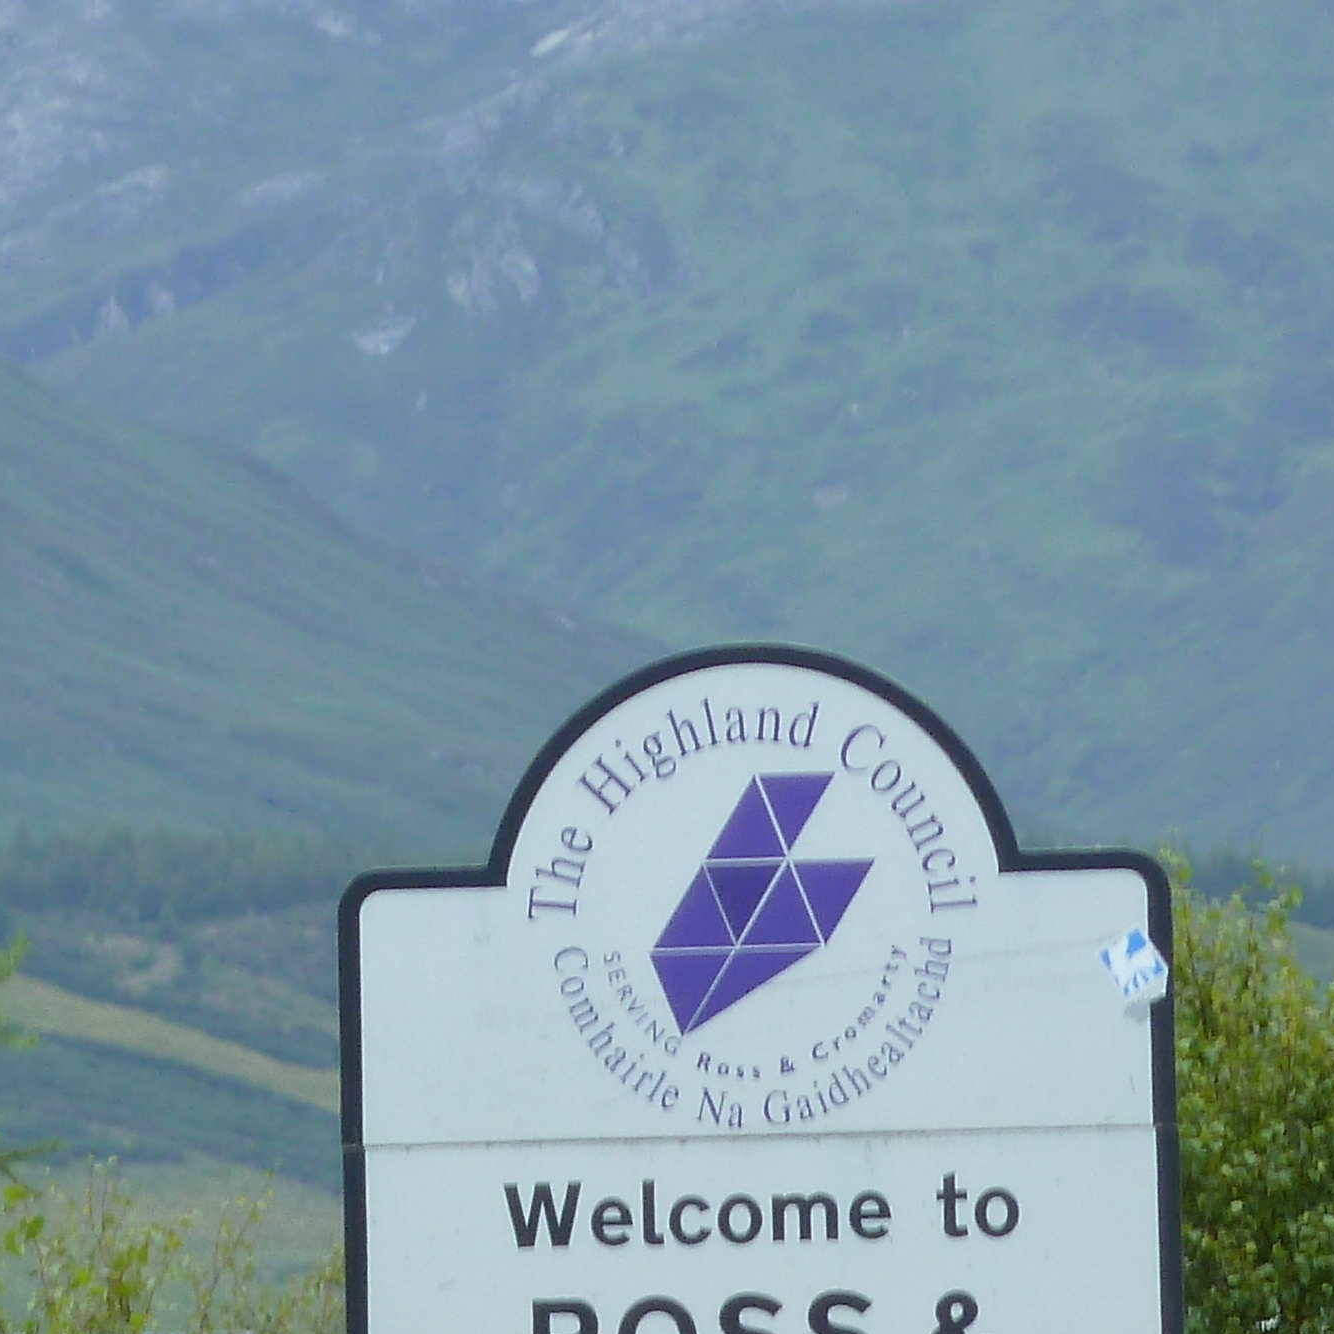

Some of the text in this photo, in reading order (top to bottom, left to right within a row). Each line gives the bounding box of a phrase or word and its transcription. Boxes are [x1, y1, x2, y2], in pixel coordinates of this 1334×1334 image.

[528, 699, 978, 918] The Highland Council
[555, 937, 952, 1128] Comhairle Na Gaidhealtachd
[604, 952, 682, 1056] SERVING
[813, 944, 908, 1060] Cromarty
[504, 1172, 1019, 1248] Welcome to
